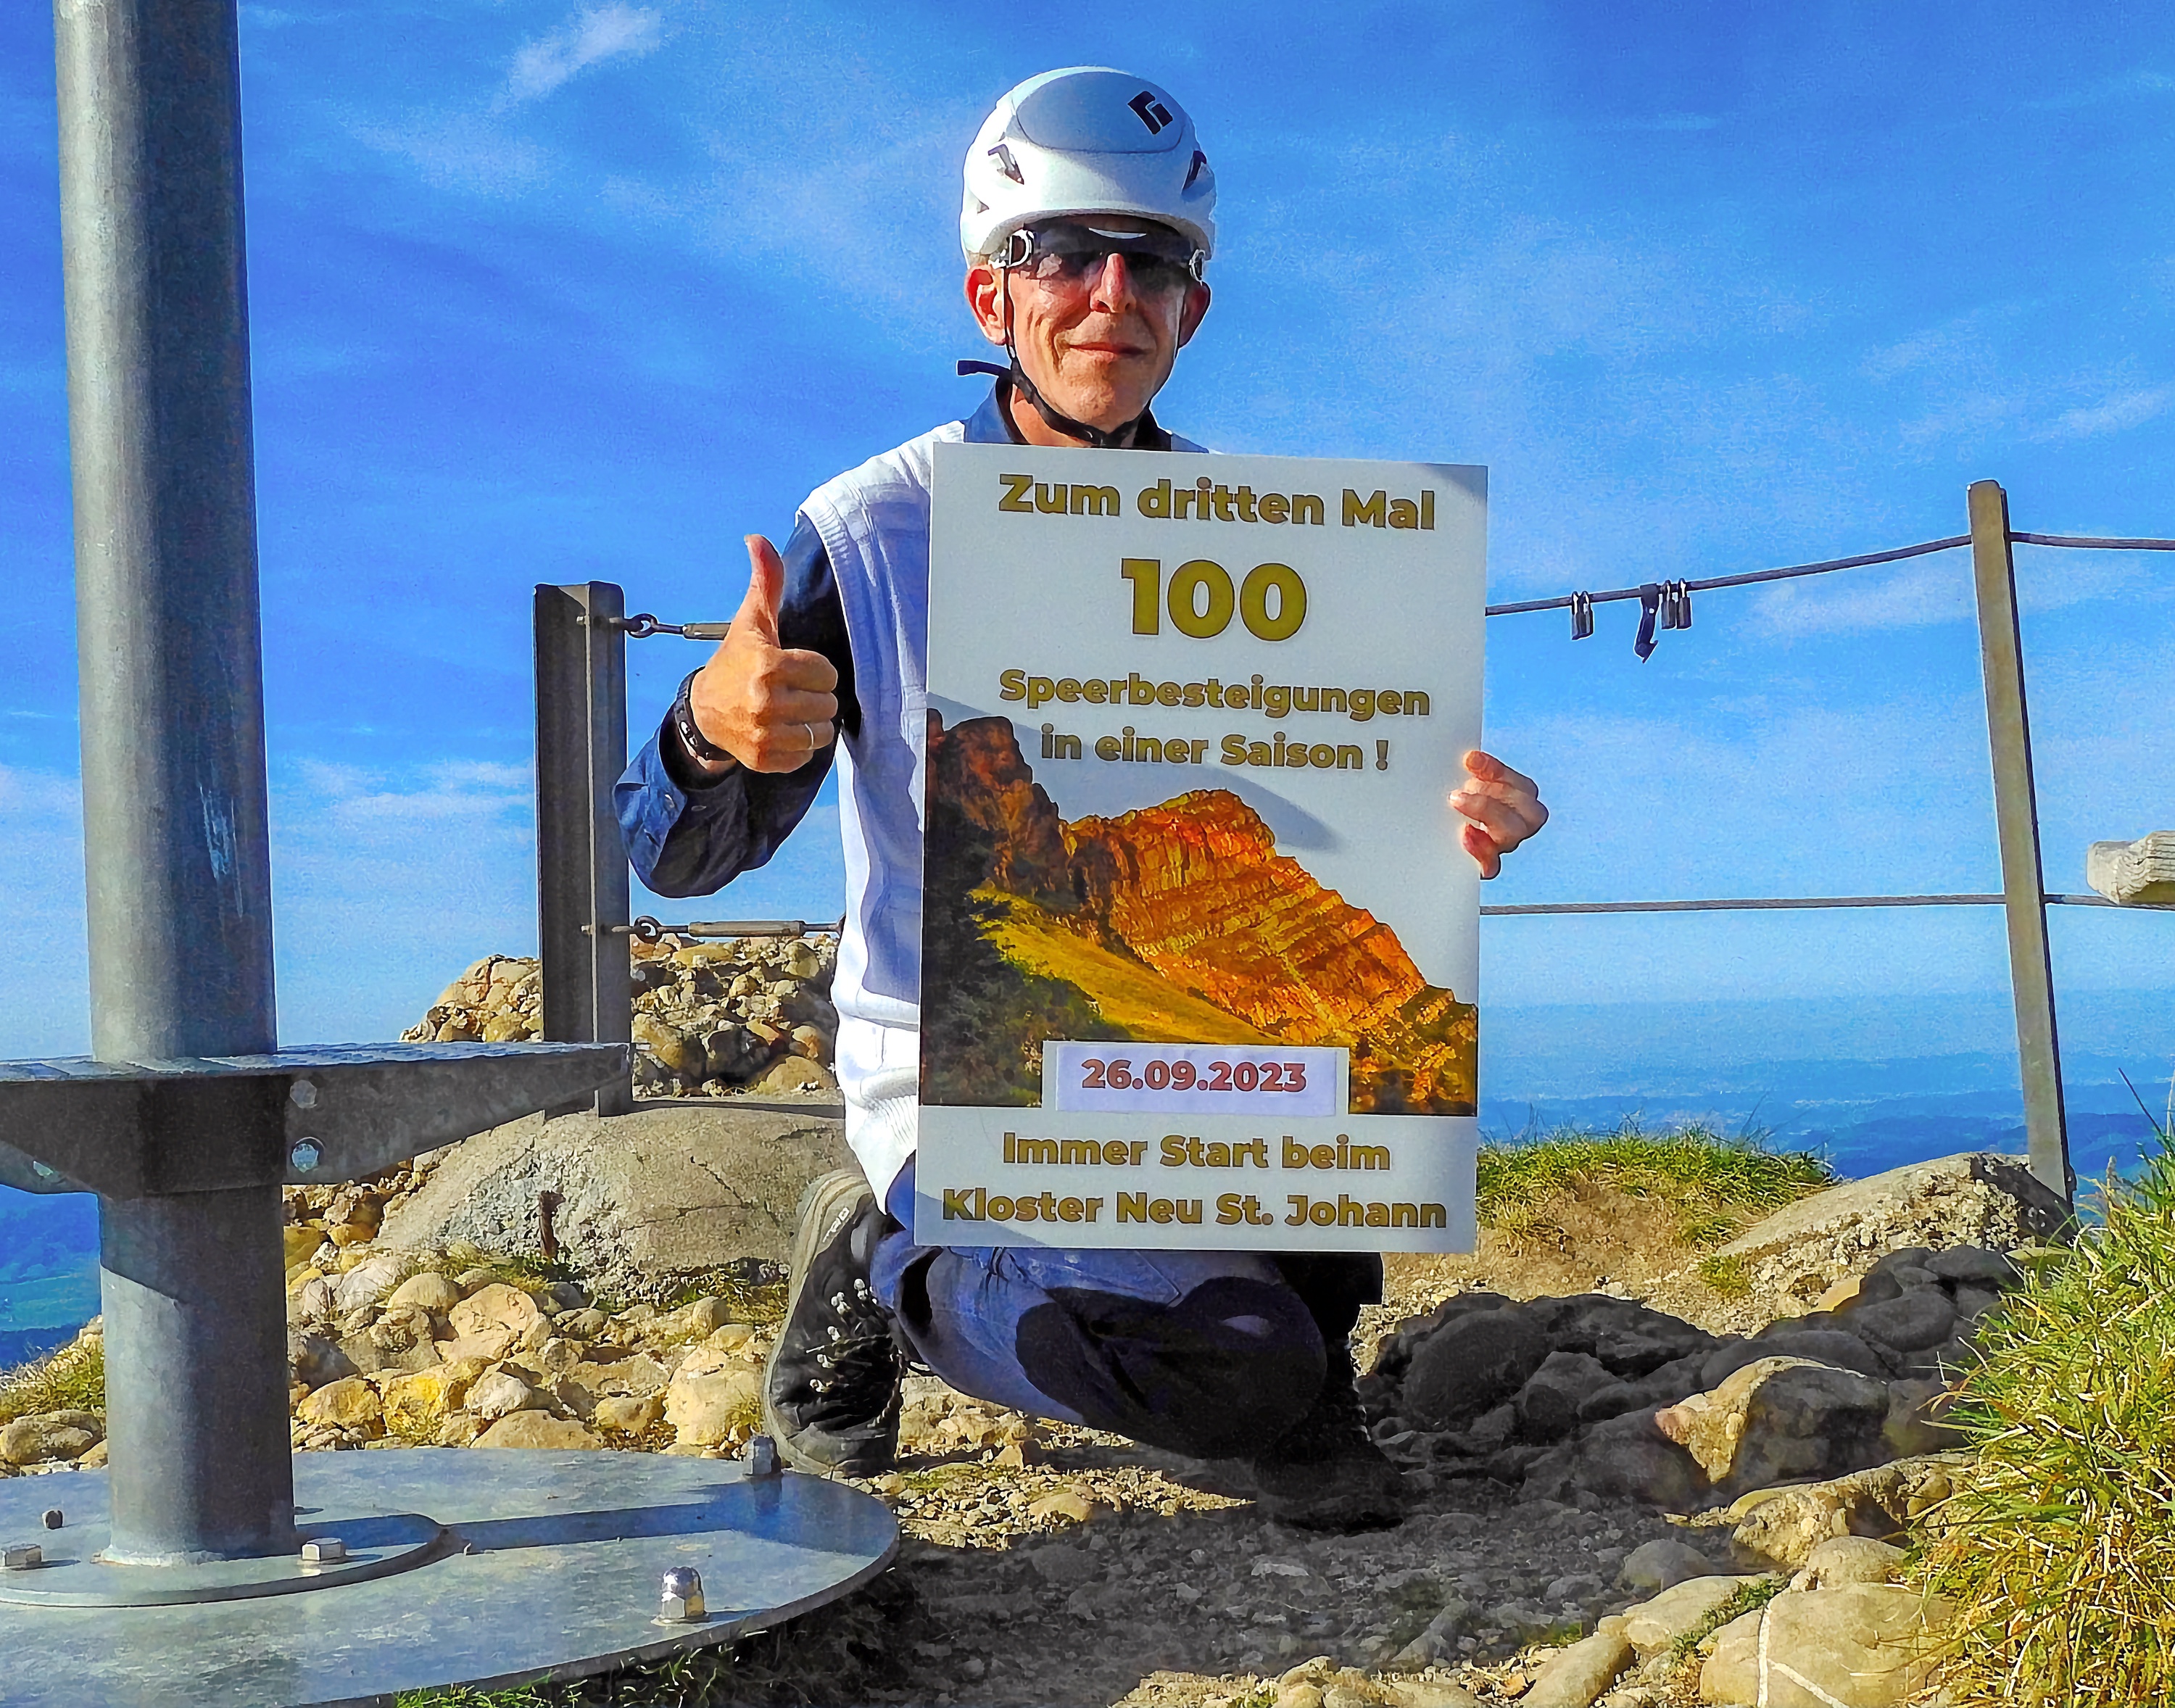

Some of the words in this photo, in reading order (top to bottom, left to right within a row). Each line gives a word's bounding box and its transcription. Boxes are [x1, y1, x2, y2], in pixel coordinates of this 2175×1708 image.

[998, 474, 1121, 517] Zum
[1137, 477, 1325, 526] dritten
[1342, 489, 1436, 531] Mal
[1121, 558, 1307, 642] 100
[999, 669, 1430, 722] Speerbesteigungen
[1040, 724, 1082, 760] in
[1094, 726, 1209, 765] einer
[1220, 731, 1363, 770] Saison
[1376, 739, 1390, 771] !
[1081, 1059, 1307, 1093] 26.09.2023
[1003, 1132, 1148, 1166] Immer
[1159, 1135, 1269, 1169] Start
[1282, 1135, 1391, 1171] beim
[942, 1187, 1103, 1223] Kloster
[1116, 1190, 1203, 1224] Neu
[1215, 1192, 1273, 1226] St.
[1284, 1194, 1446, 1229] Johann
